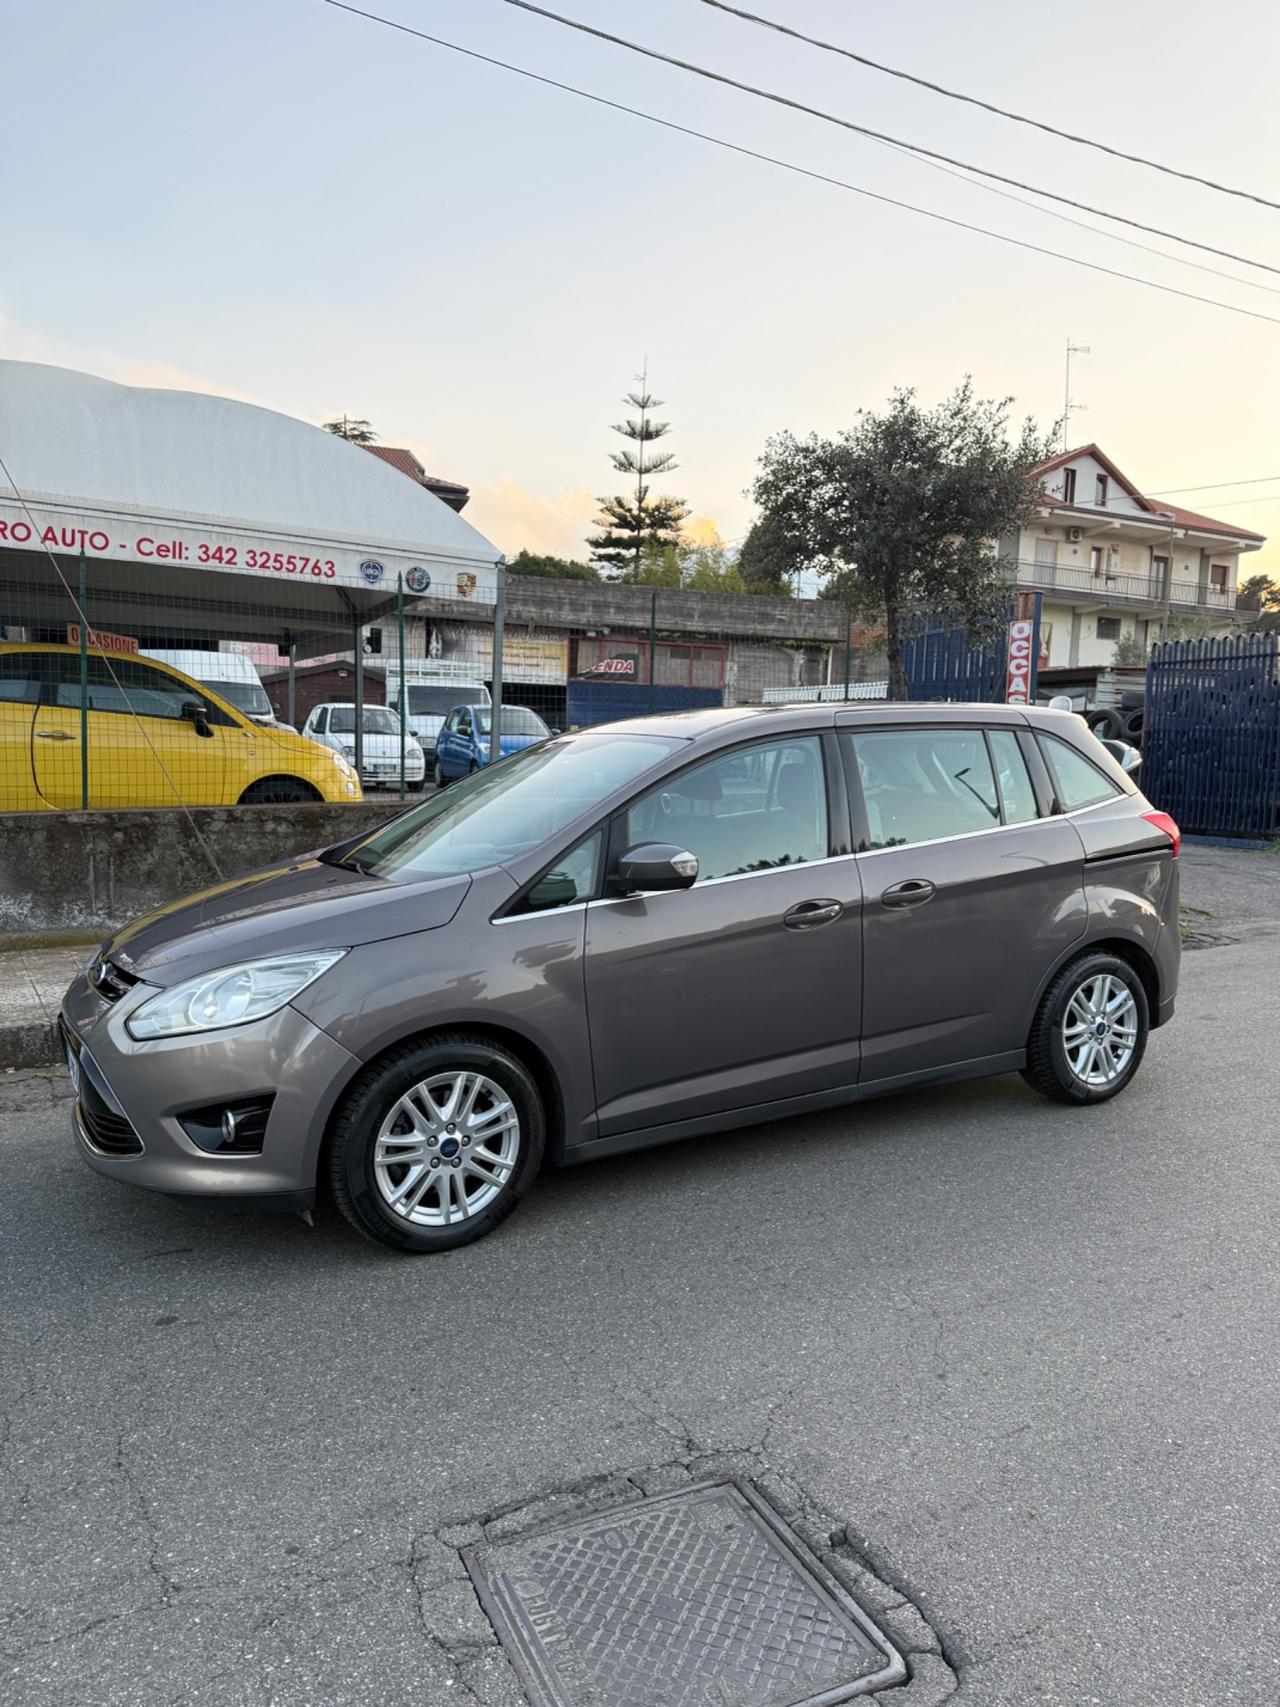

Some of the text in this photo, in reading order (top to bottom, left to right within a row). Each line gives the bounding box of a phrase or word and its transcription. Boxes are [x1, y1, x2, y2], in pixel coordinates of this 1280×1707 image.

[0, 521, 31, 542] RO
[40, 526, 109, 551] AUTO
[136, 537, 189, 560] Cell:
[198, 543, 238, 566] 342
[245, 549, 336, 578] 3255763
[71, 627, 137, 653] OCASIONE
[591, 659, 634, 674] ENDA
